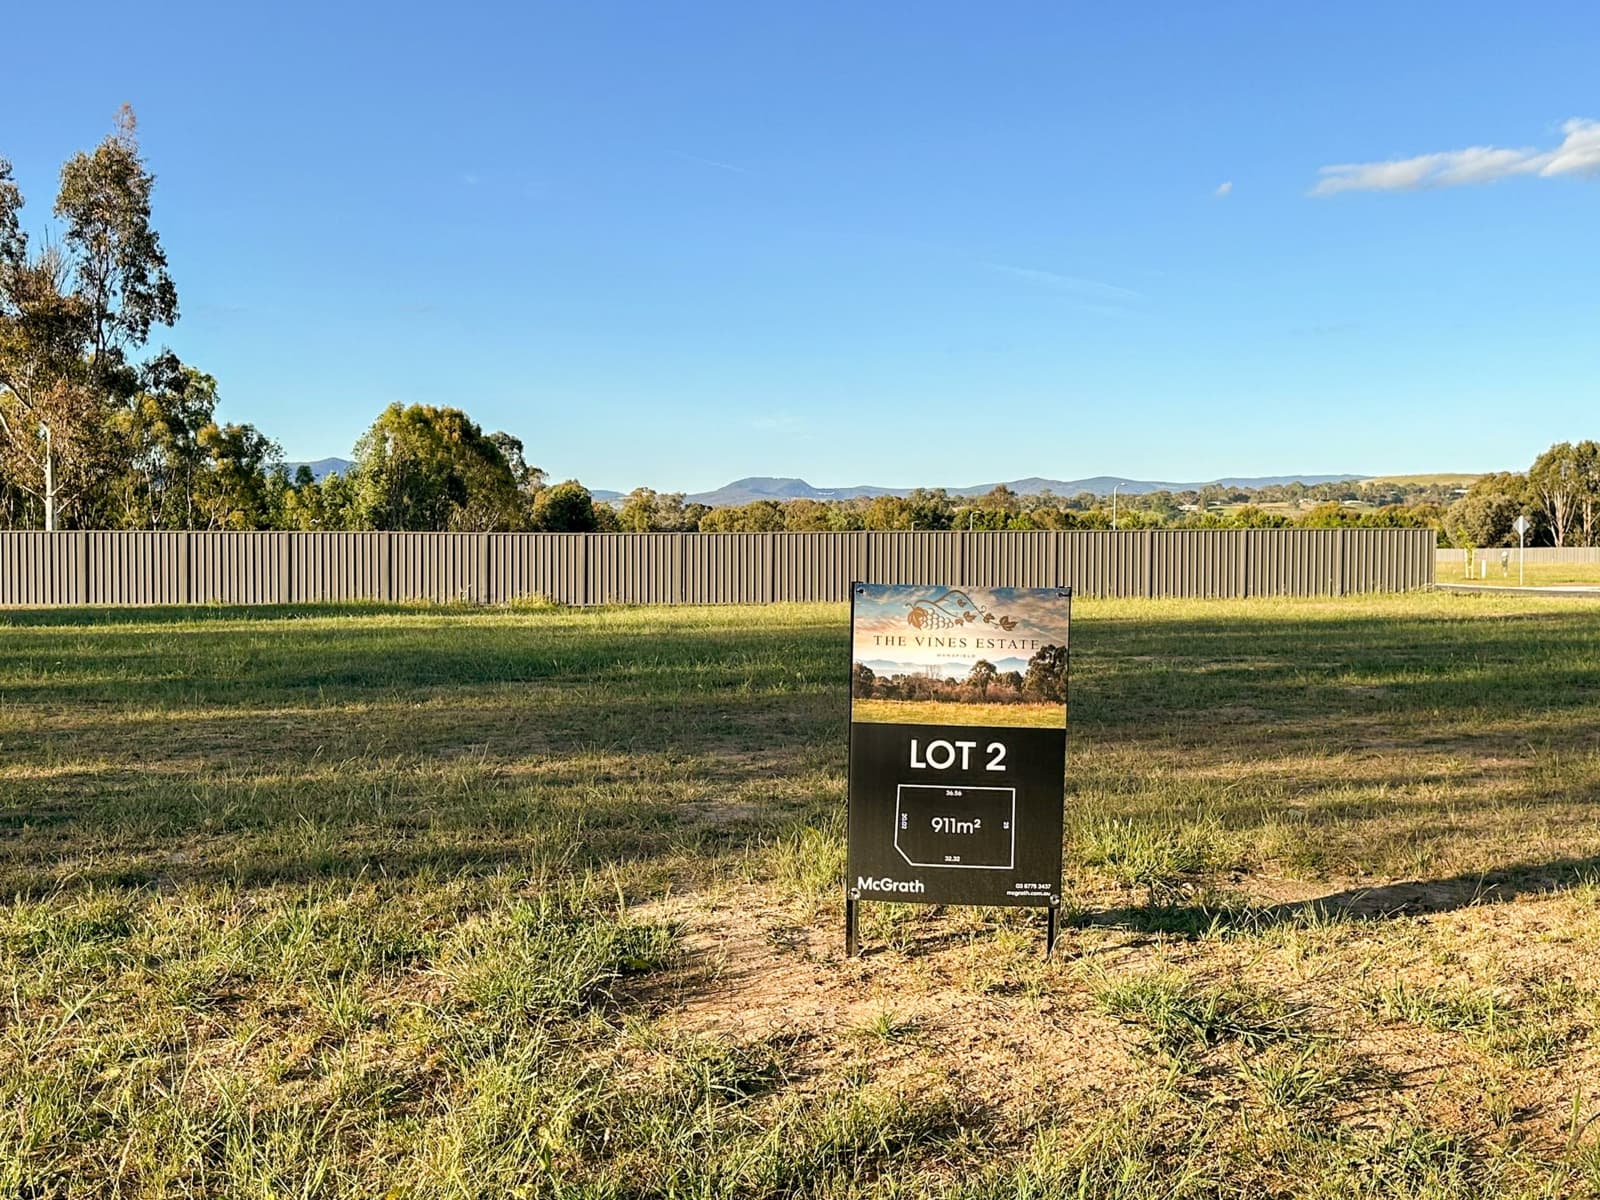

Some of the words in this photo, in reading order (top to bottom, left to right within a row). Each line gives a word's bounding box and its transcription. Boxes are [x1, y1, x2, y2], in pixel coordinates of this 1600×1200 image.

[873, 635, 907, 647] THE
[913, 636, 968, 649] VINES
[976, 638, 1040, 650] ESTATE
[910, 739, 977, 770] LOT
[985, 742, 1007, 771] 2
[857, 876, 925, 894] McGrath
